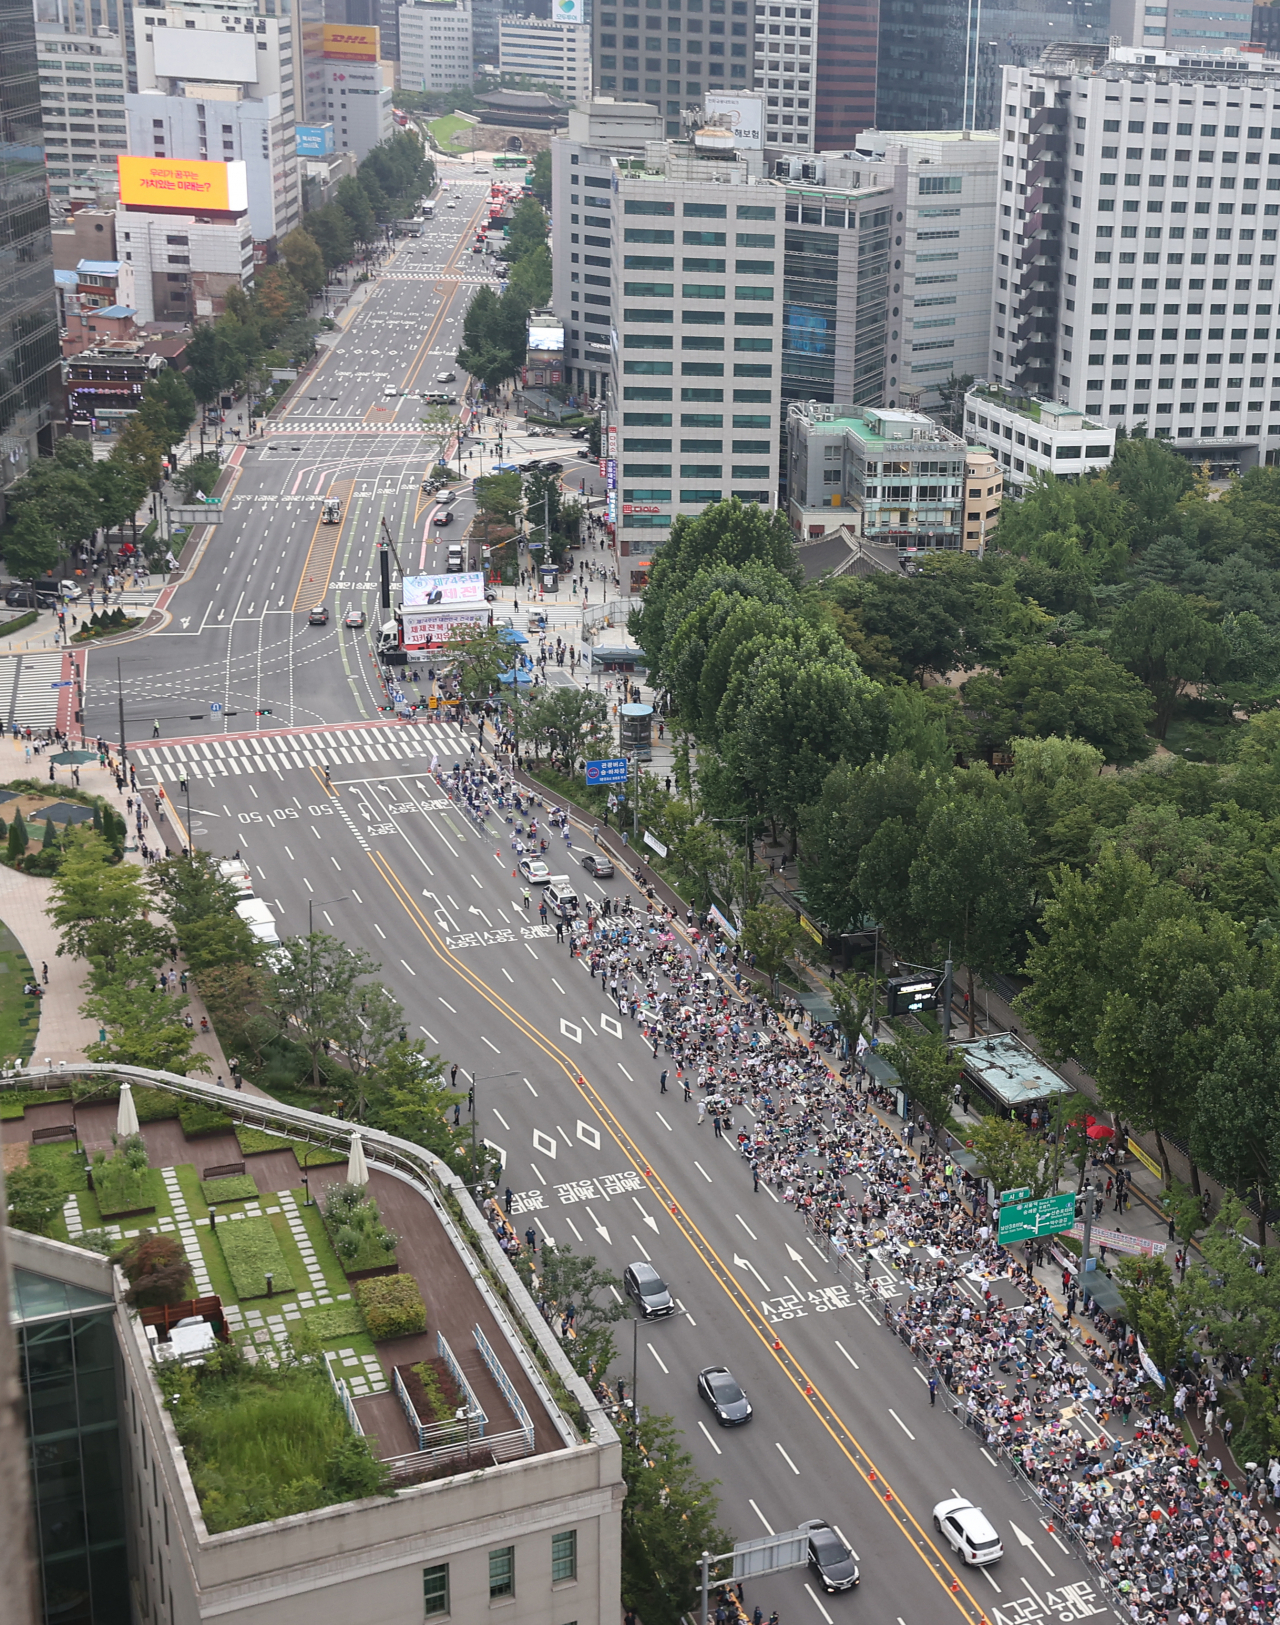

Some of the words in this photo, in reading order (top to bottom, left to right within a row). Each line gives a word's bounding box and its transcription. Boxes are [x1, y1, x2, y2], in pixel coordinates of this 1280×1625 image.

[331, 34, 368, 44] DHL
[150, 168, 174, 178] 우리가
[140, 179, 176, 190] 가치있는
[178, 181, 212, 192] 미래는?
[434, 574, 480, 586] 제74주년
[308, 804, 334, 816] 50
[388, 802, 419, 814] 소공로
[421, 799, 452, 810] 숭례문
[238, 812, 264, 824] 50
[273, 808, 299, 820] 50
[368, 823, 398, 836] 소공로
[483, 928, 518, 944] 소공로
[520, 924, 556, 939] 숭례문
[445, 934, 480, 950] 소공로
[599, 1171, 646, 1194] 광화문
[553, 1180, 600, 1204] 광화문
[808, 1285, 856, 1312] 숭례문
[760, 1294, 808, 1323] 소공로
[1046, 1581, 1108, 1622] 숭례문
